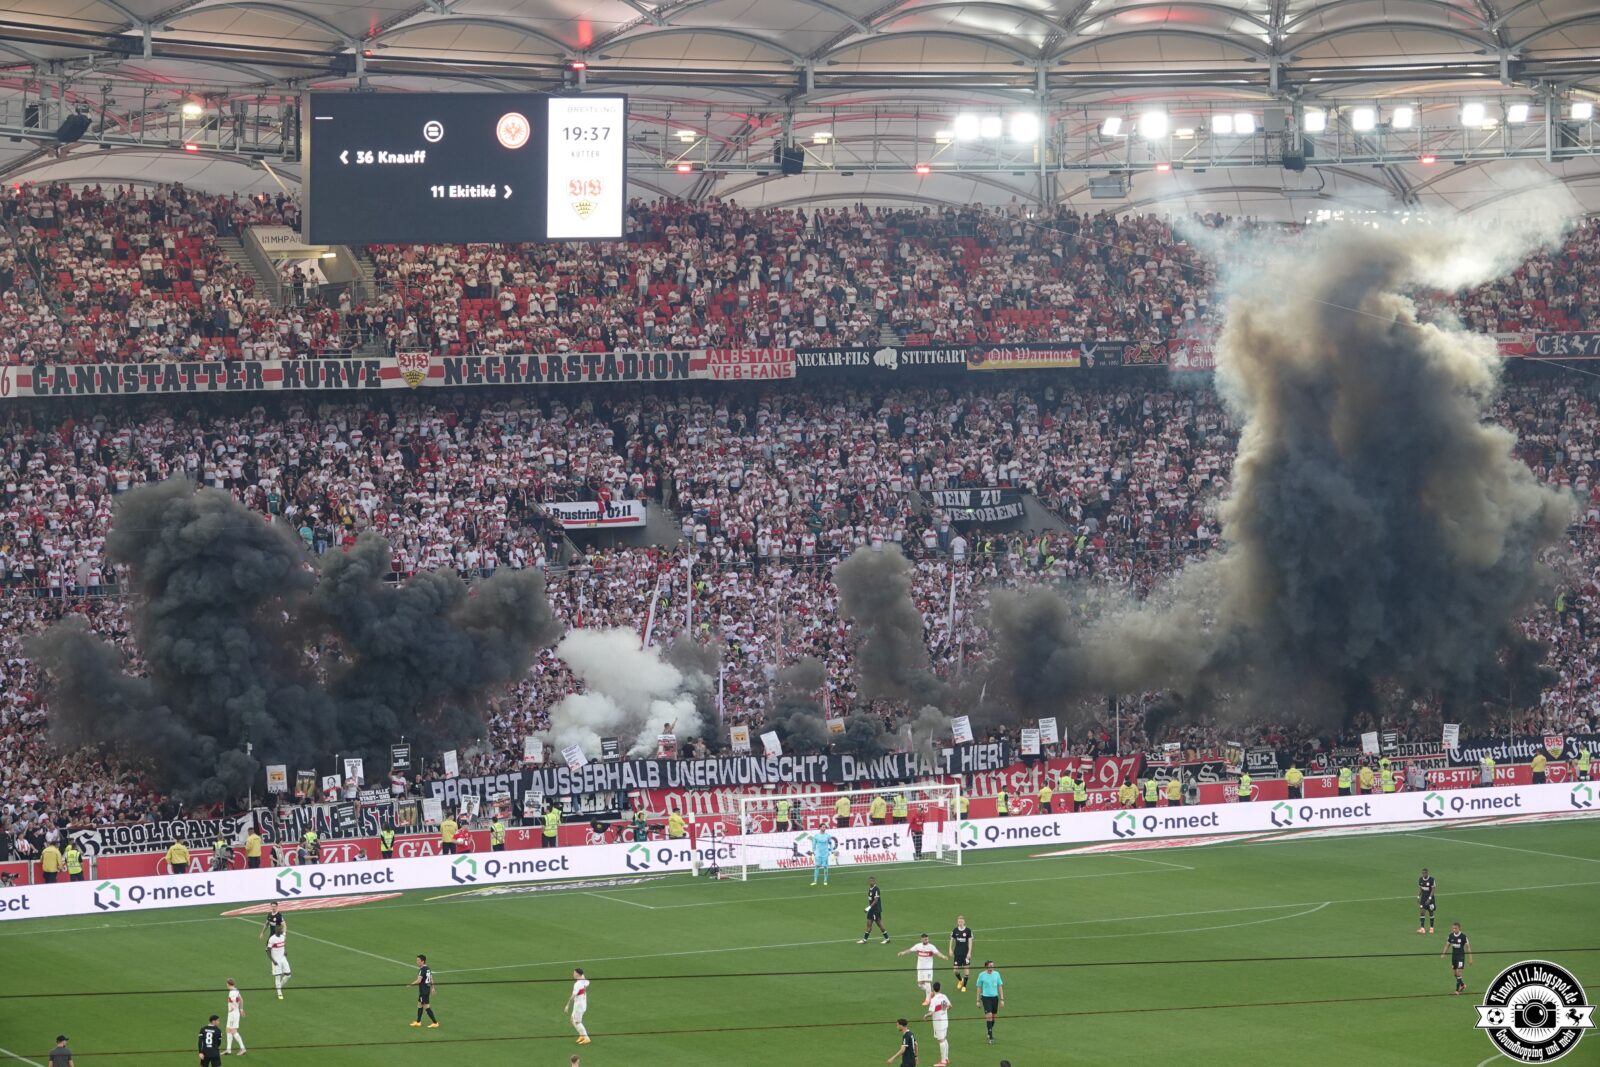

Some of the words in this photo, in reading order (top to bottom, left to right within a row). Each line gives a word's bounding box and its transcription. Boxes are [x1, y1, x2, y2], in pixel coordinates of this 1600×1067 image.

[563, 127, 610, 141] 19:37
[356, 151, 373, 164] 36
[378, 150, 426, 164] Knauff
[431, 185, 445, 198] 11
[449, 183, 497, 198] Ekitiké
[710, 348, 794, 364] ALBSTADT
[796, 350, 870, 367] NECKAR-FILS
[901, 349, 967, 365] STUTTGART
[1016, 346, 1073, 364] Warriors
[32, 360, 265, 395] CANNSTATTER
[282, 359, 381, 389] KURVE
[443, 352, 690, 385] NECKARSTADION
[711, 364, 791, 379] VFB-FANS
[932, 490, 971, 506] NEIN
[981, 489, 1001, 506] ZU
[941, 502, 1024, 522] VESTOREN!
[1246, 752, 1278, 766] 50+1
[431, 773, 523, 807] PROTEST
[530, 761, 660, 797] AUSSERHALB
[842, 754, 899, 781] DANN
[905, 748, 954, 777] HALT
[961, 743, 1003, 772] HIER!
[1100, 757, 1136, 789] 97
[1321, 778, 1332, 788] 36
[1299, 802, 1371, 821] Q-nnect
[1450, 793, 1522, 813] Q-nnect
[1143, 812, 1219, 832] Q-nnect
[98, 817, 237, 847] HOOLIGANS
[518, 829, 530, 841] 34
[985, 821, 1061, 842] Q-nnect
[484, 855, 569, 877] Q-nnect
[776, 858, 816, 869] WINAMA
[854, 852, 898, 863] WINAMAX
[309, 867, 395, 890] Q-nnect
[128, 880, 215, 904] Q-nnect
[205, 1032, 213, 1045] 8
